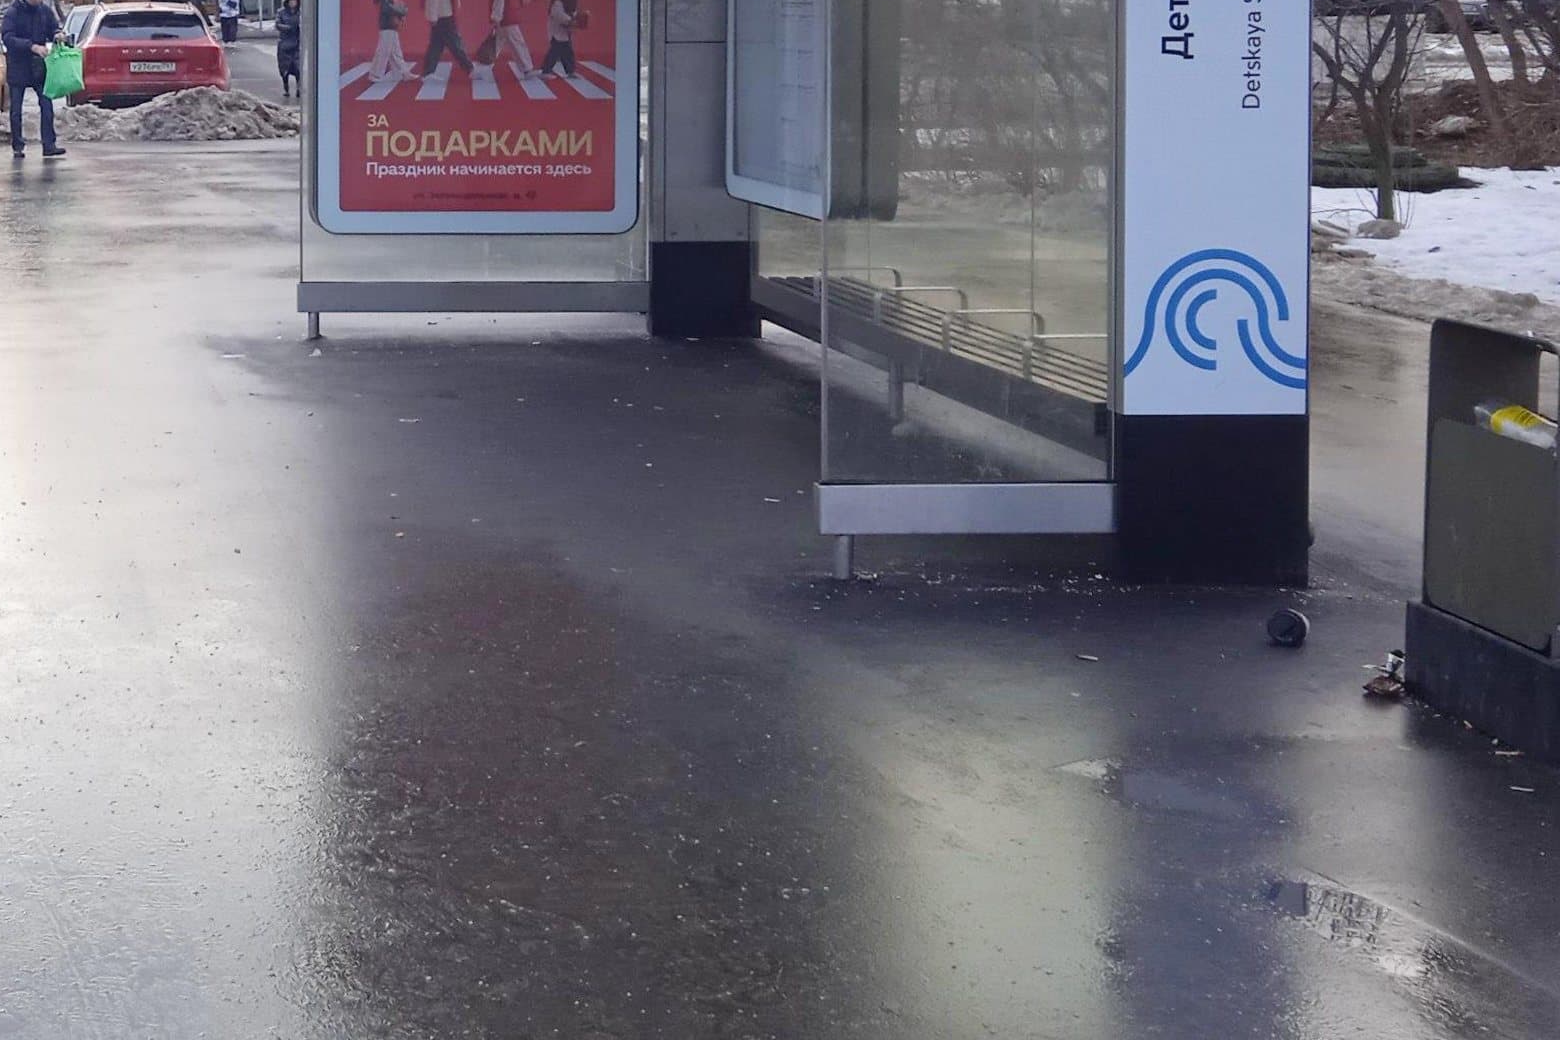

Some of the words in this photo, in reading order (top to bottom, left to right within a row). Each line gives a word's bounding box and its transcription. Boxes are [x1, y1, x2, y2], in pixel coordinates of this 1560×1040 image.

[1242, 11, 1264, 109] Detskaya
[367, 114, 389, 128] ЗА
[366, 130, 593, 162] ПОДАРКАМИ
[366, 162, 446, 178] Праздник
[450, 164, 541, 176] начинается
[546, 164, 592, 177] здесь
